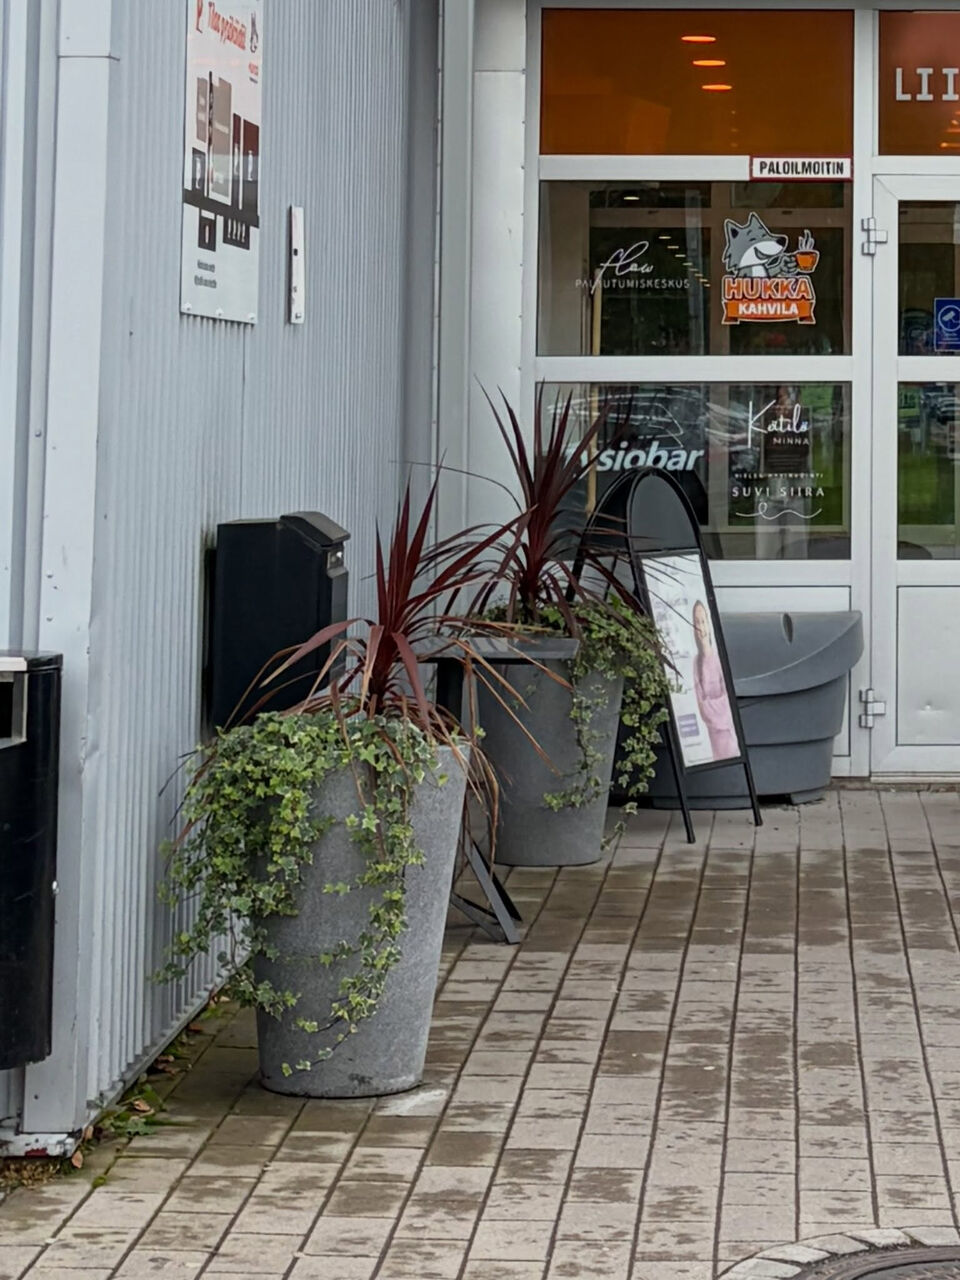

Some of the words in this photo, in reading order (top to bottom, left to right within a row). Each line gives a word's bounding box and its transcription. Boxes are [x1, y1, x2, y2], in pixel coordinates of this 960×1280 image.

[759, 160, 844, 175] PALOILMOITIN
[575, 279, 691, 289] PALUTUMISKESKUS
[725, 277, 813, 300] HUKKA
[738, 302, 799, 316] KAHVILA
[772, 437, 810, 445] MINNA
[732, 486, 770, 497] SUVI
[779, 486, 825, 497] SIIRA
